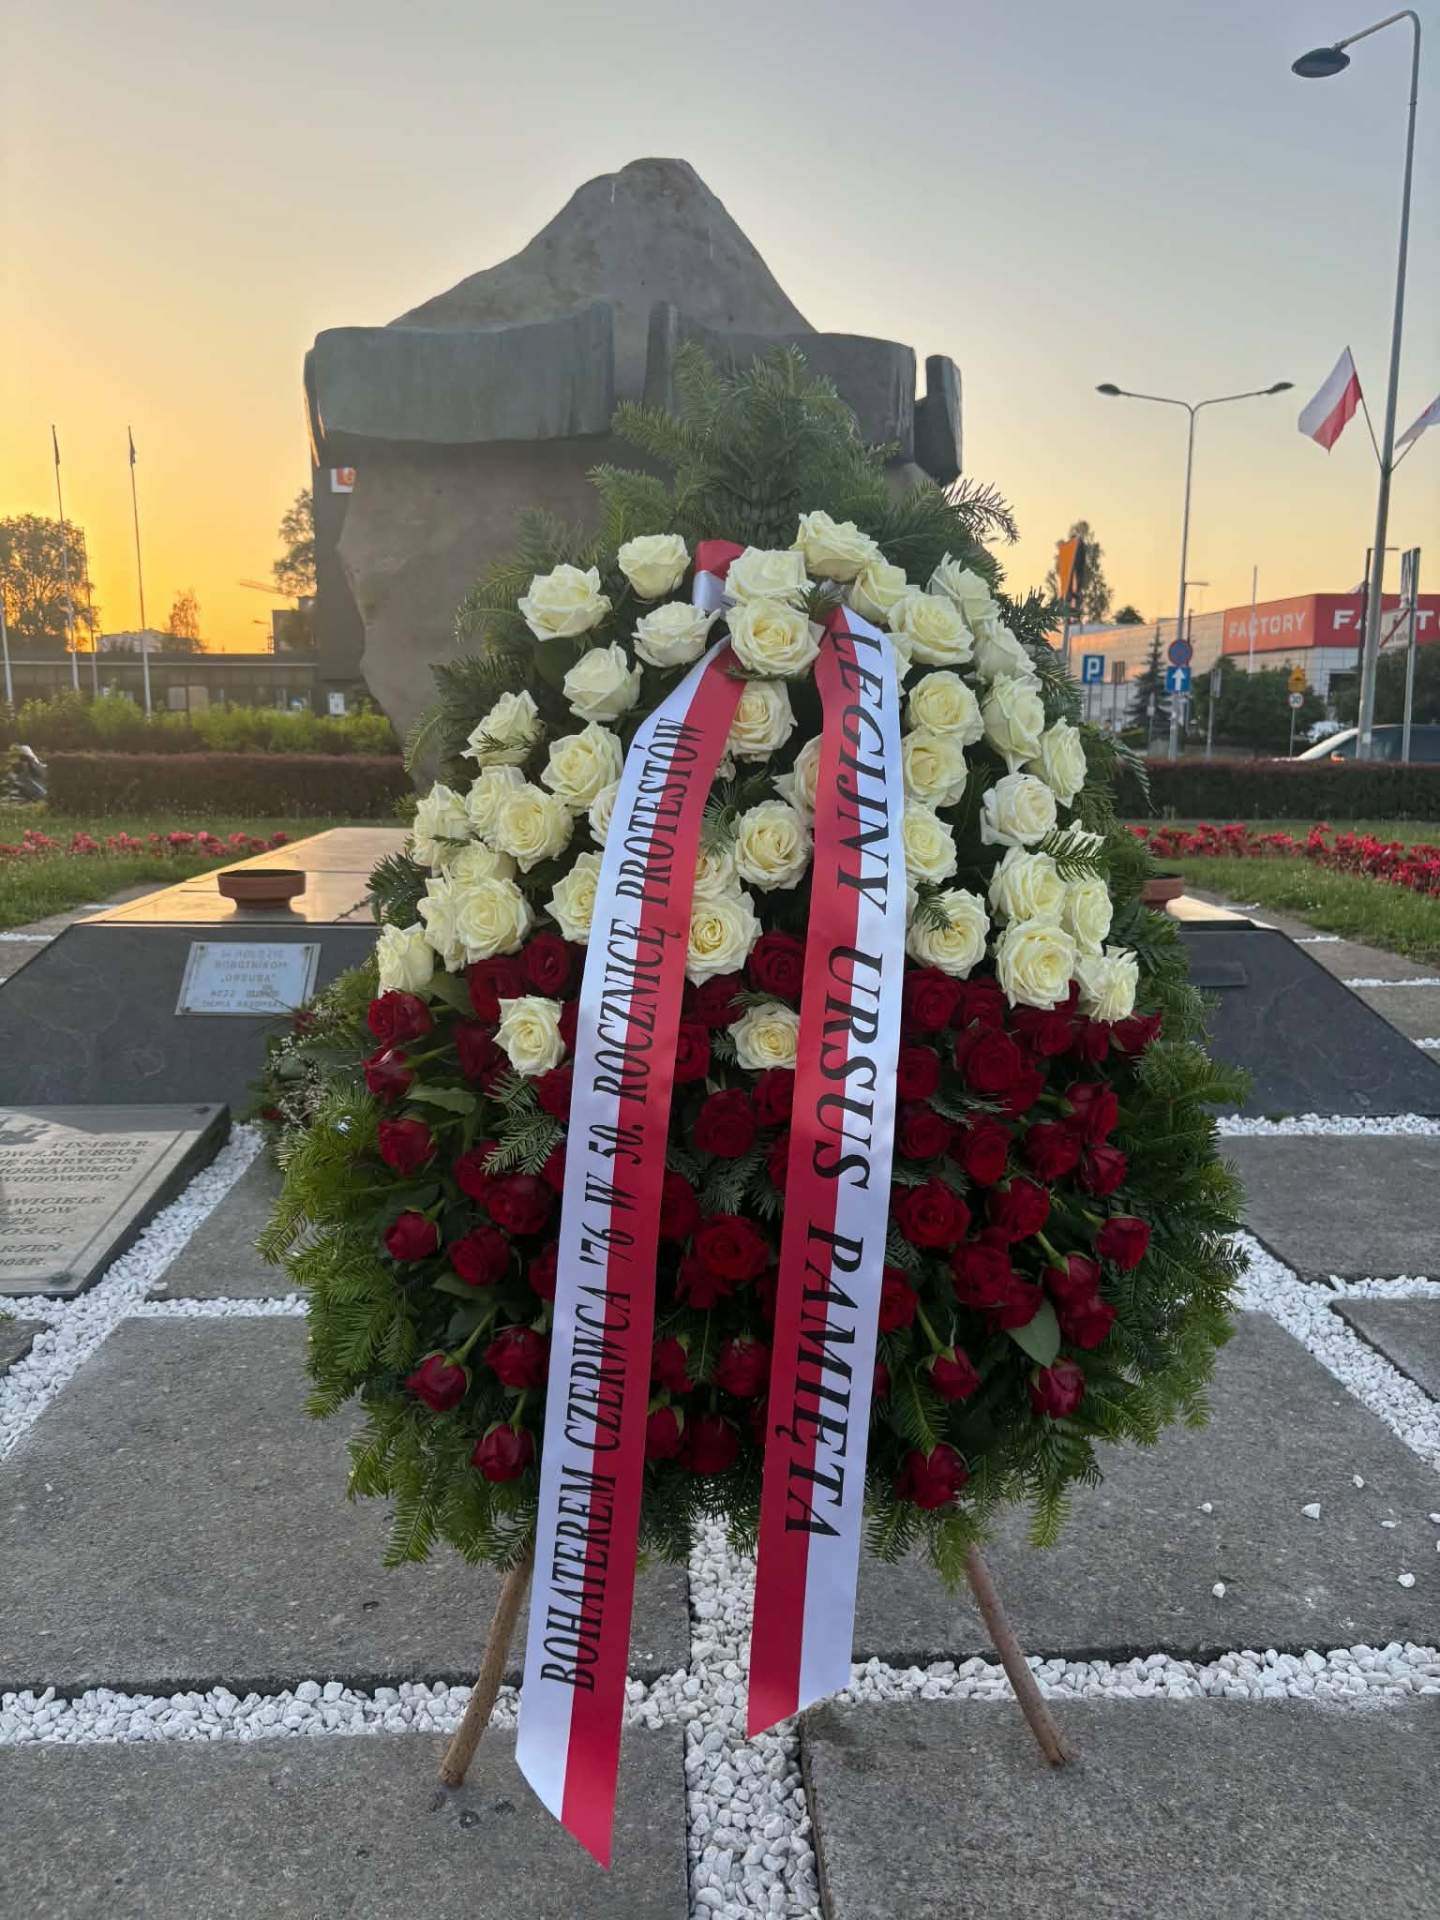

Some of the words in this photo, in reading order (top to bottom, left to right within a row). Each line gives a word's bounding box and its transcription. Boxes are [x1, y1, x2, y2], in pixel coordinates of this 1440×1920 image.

[1087, 656, 1100, 680] P
[615, 717, 706, 909] PROTESTÓW
[829, 630, 890, 917] LEGIJNY
[592, 917, 682, 1105] ROCZNICĘ
[812, 945, 884, 1191] URSUS
[584, 1170, 640, 1213] W
[588, 1123, 645, 1166] 50.
[564, 1285, 632, 1453] CZERWCA
[775, 1220, 864, 1538] PAMIĘTA
[540, 1464, 616, 1692] BOHATEREM
